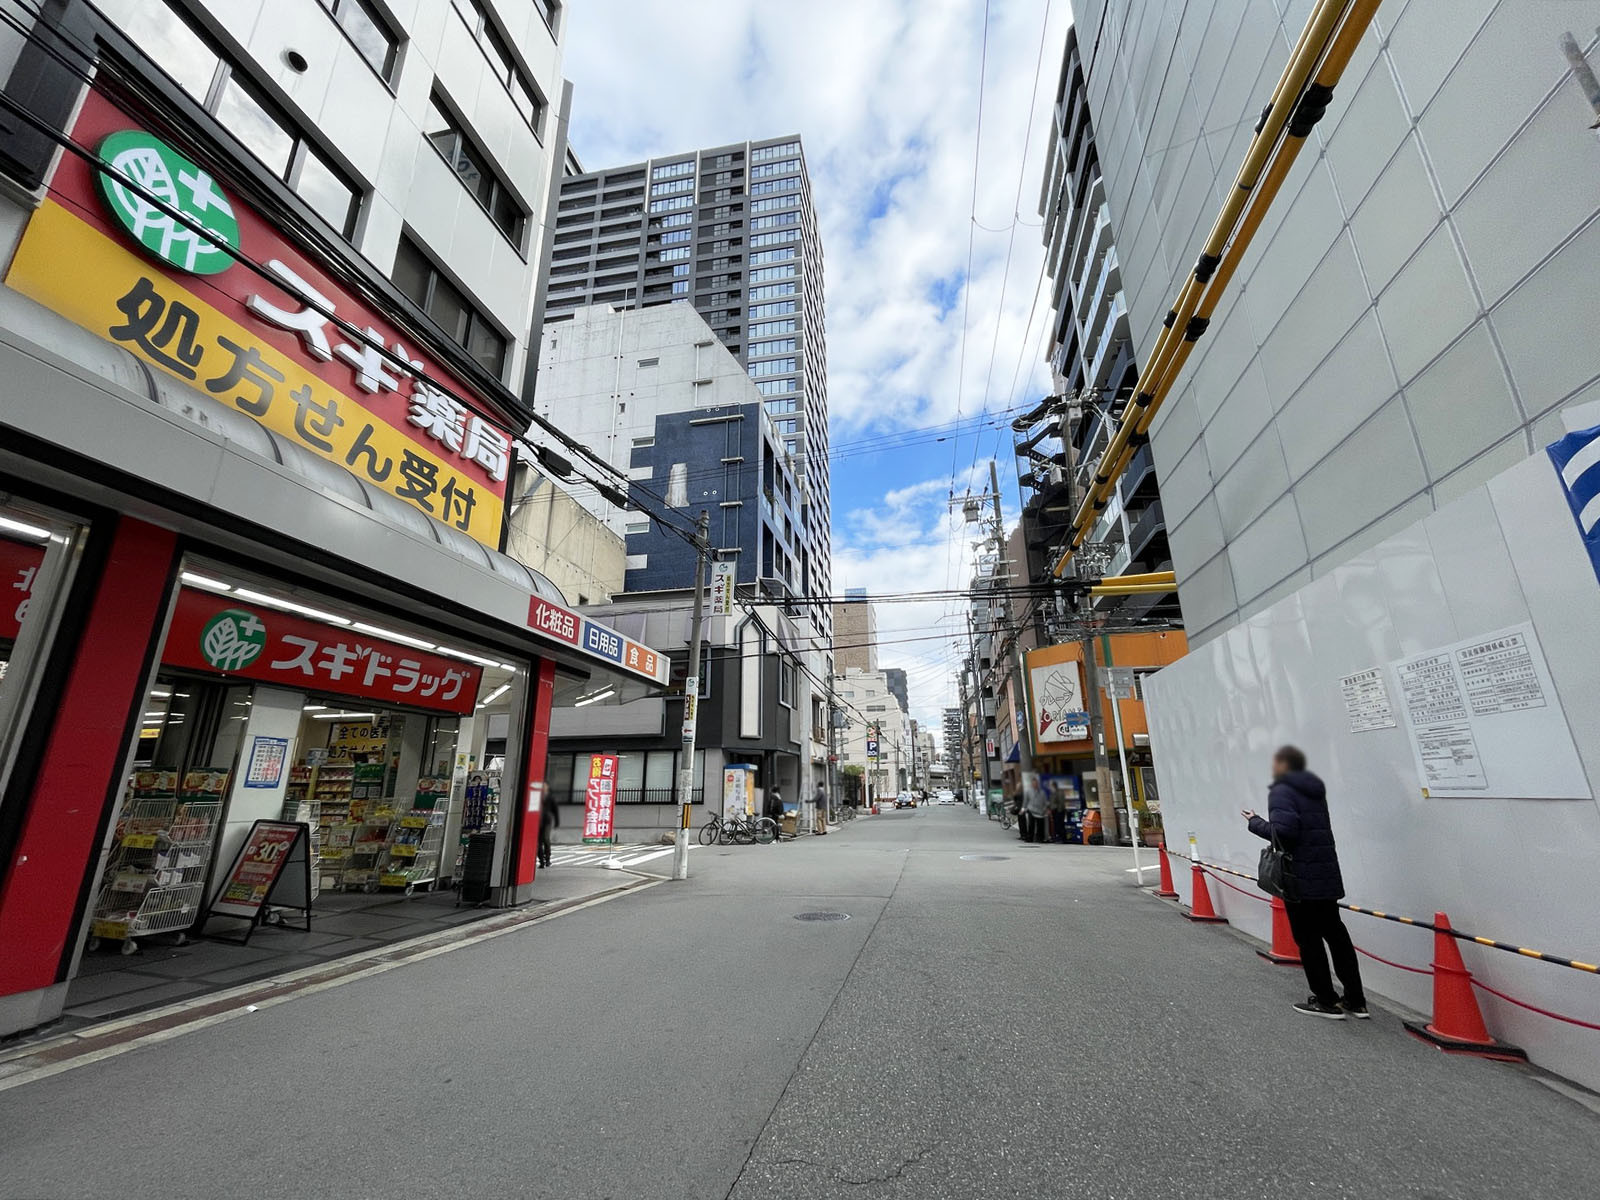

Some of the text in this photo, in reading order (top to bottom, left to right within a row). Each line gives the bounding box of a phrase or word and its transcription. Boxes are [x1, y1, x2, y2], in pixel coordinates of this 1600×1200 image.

[246, 259, 511, 482] スギ薬局
[108, 275, 477, 532] 処方せん受付
[535, 603, 575, 639] 化粧品
[589, 627, 619, 657] 日用品
[630, 647, 654, 673] 食品
[270, 635, 472, 701] スギドラッグ
[870, 742, 877, 751] P
